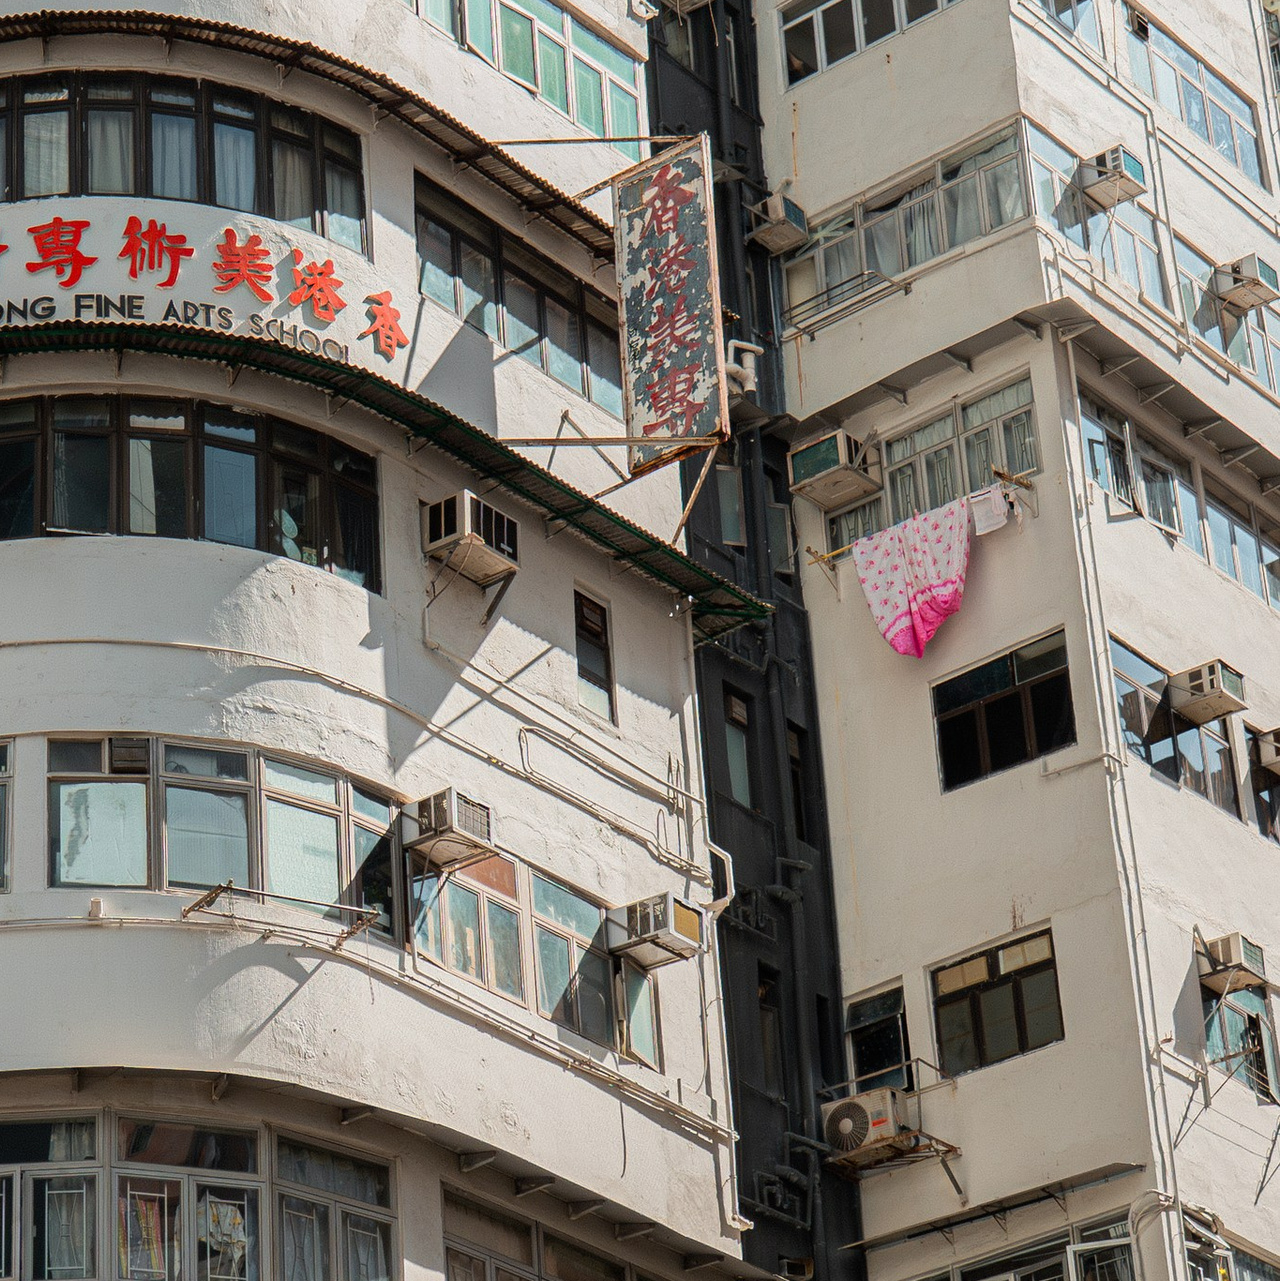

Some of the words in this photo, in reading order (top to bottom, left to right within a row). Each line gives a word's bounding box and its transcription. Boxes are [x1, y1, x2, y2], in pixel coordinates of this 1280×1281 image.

[75, 294, 145, 320] FINE
[163, 300, 234, 331] ARTS
[642, 164, 705, 438] 香港美專
